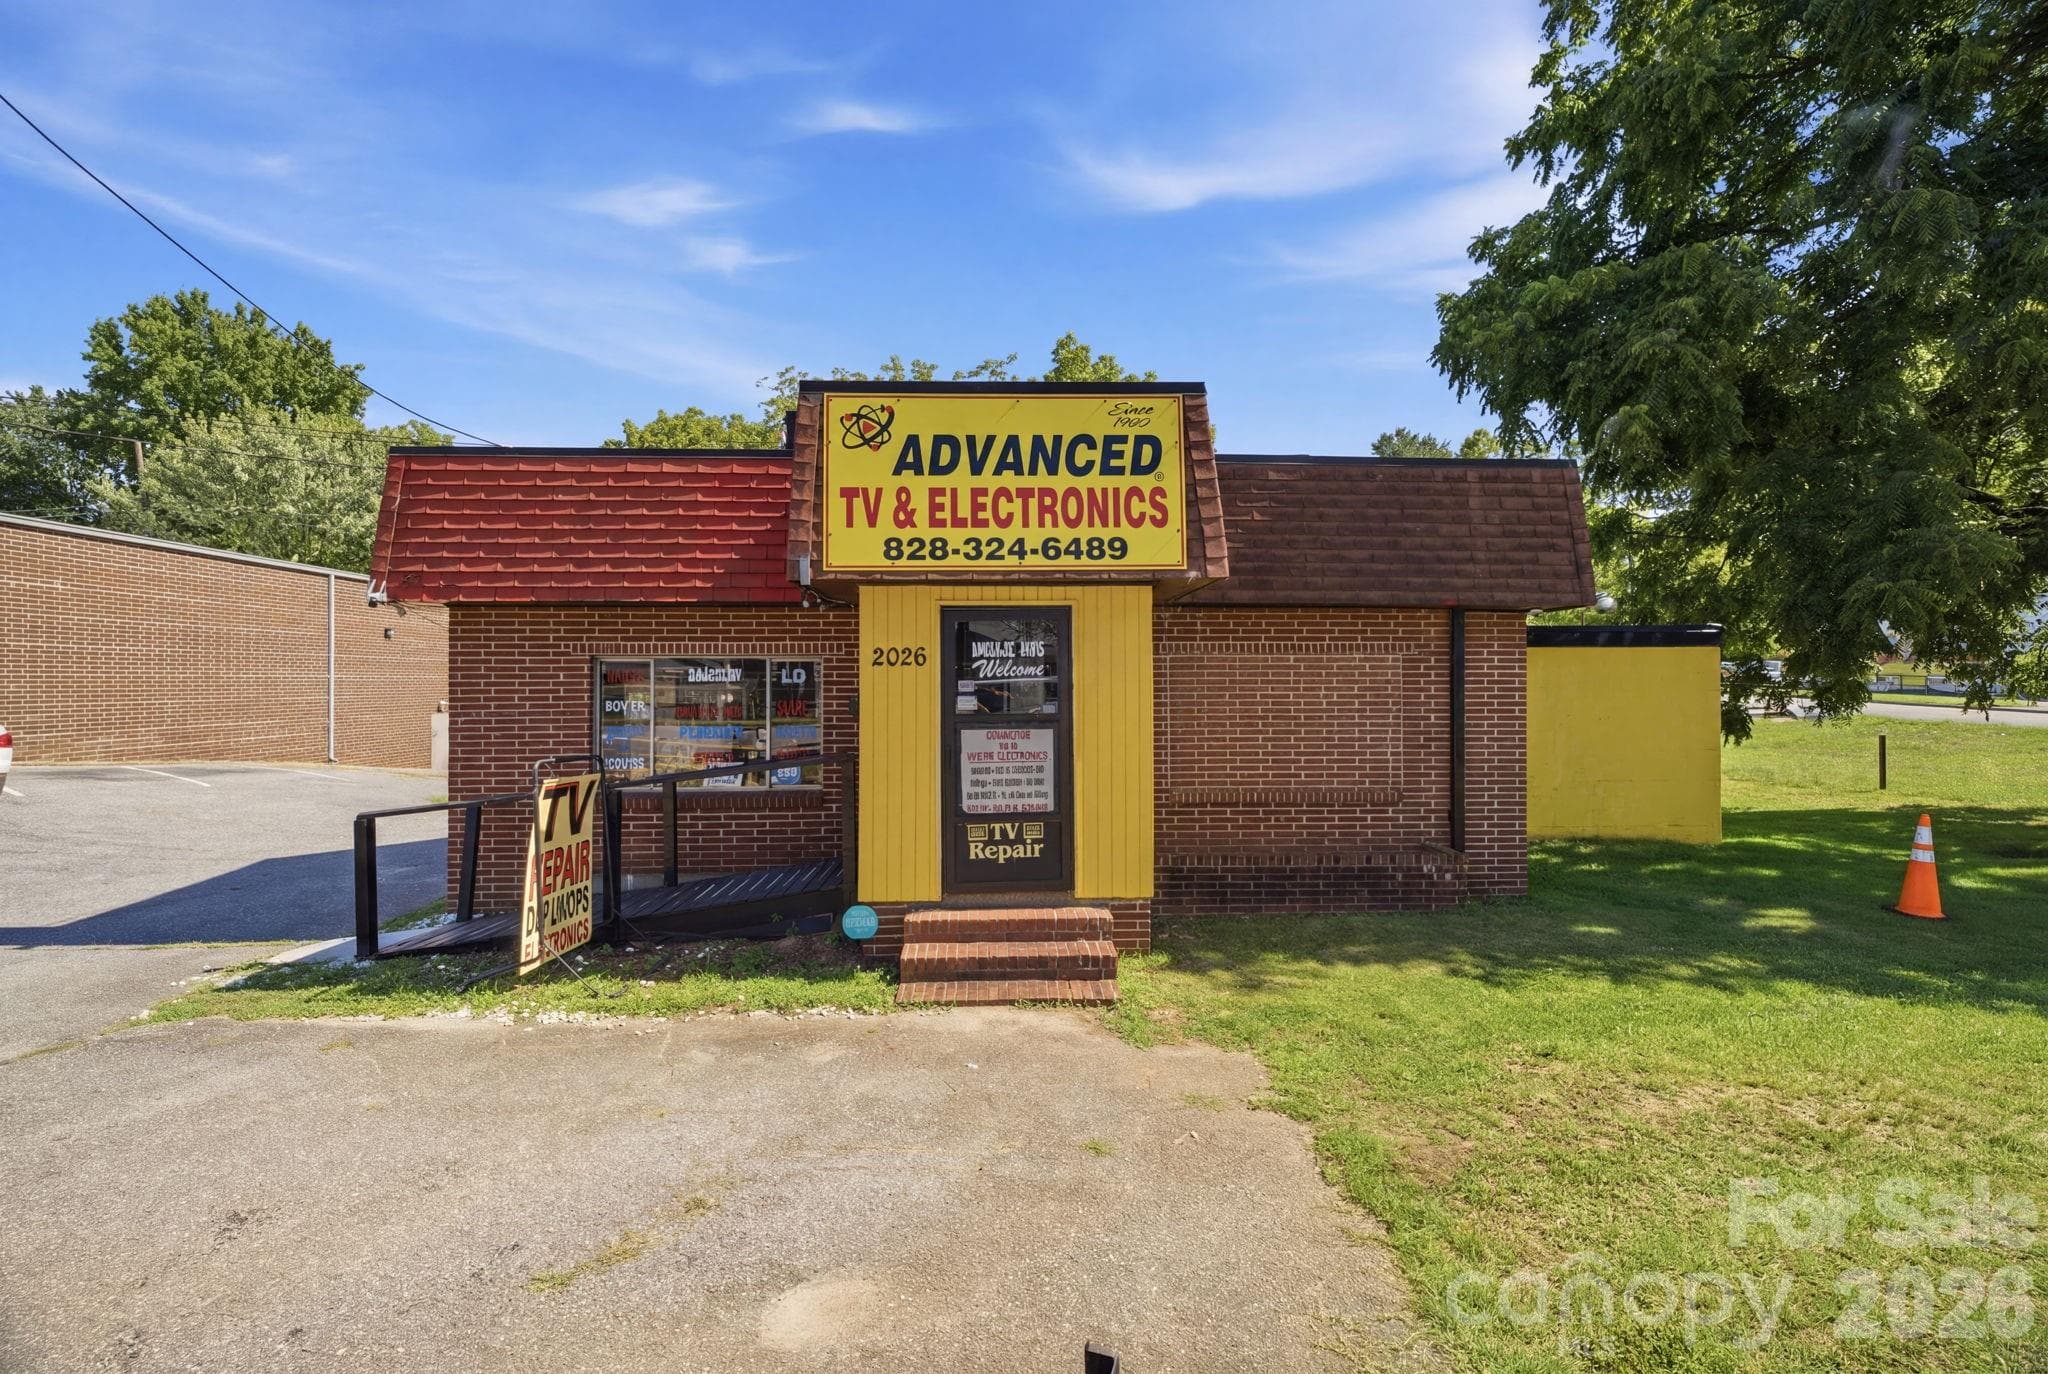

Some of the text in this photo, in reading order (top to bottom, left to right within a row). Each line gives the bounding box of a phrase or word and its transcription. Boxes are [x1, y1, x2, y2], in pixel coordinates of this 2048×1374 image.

[1108, 402, 1154, 416] Since
[892, 434, 1163, 477] ADVANCED
[840, 486, 1169, 529] TV & ELECTRONICS
[883, 536, 1128, 561] 828-324-6489
[872, 647, 927, 667] 2026
[972, 659, 1045, 678] Welcome
[543, 780, 597, 843] TV
[990, 823, 1020, 839] TV
[969, 839, 1044, 863] Repair
